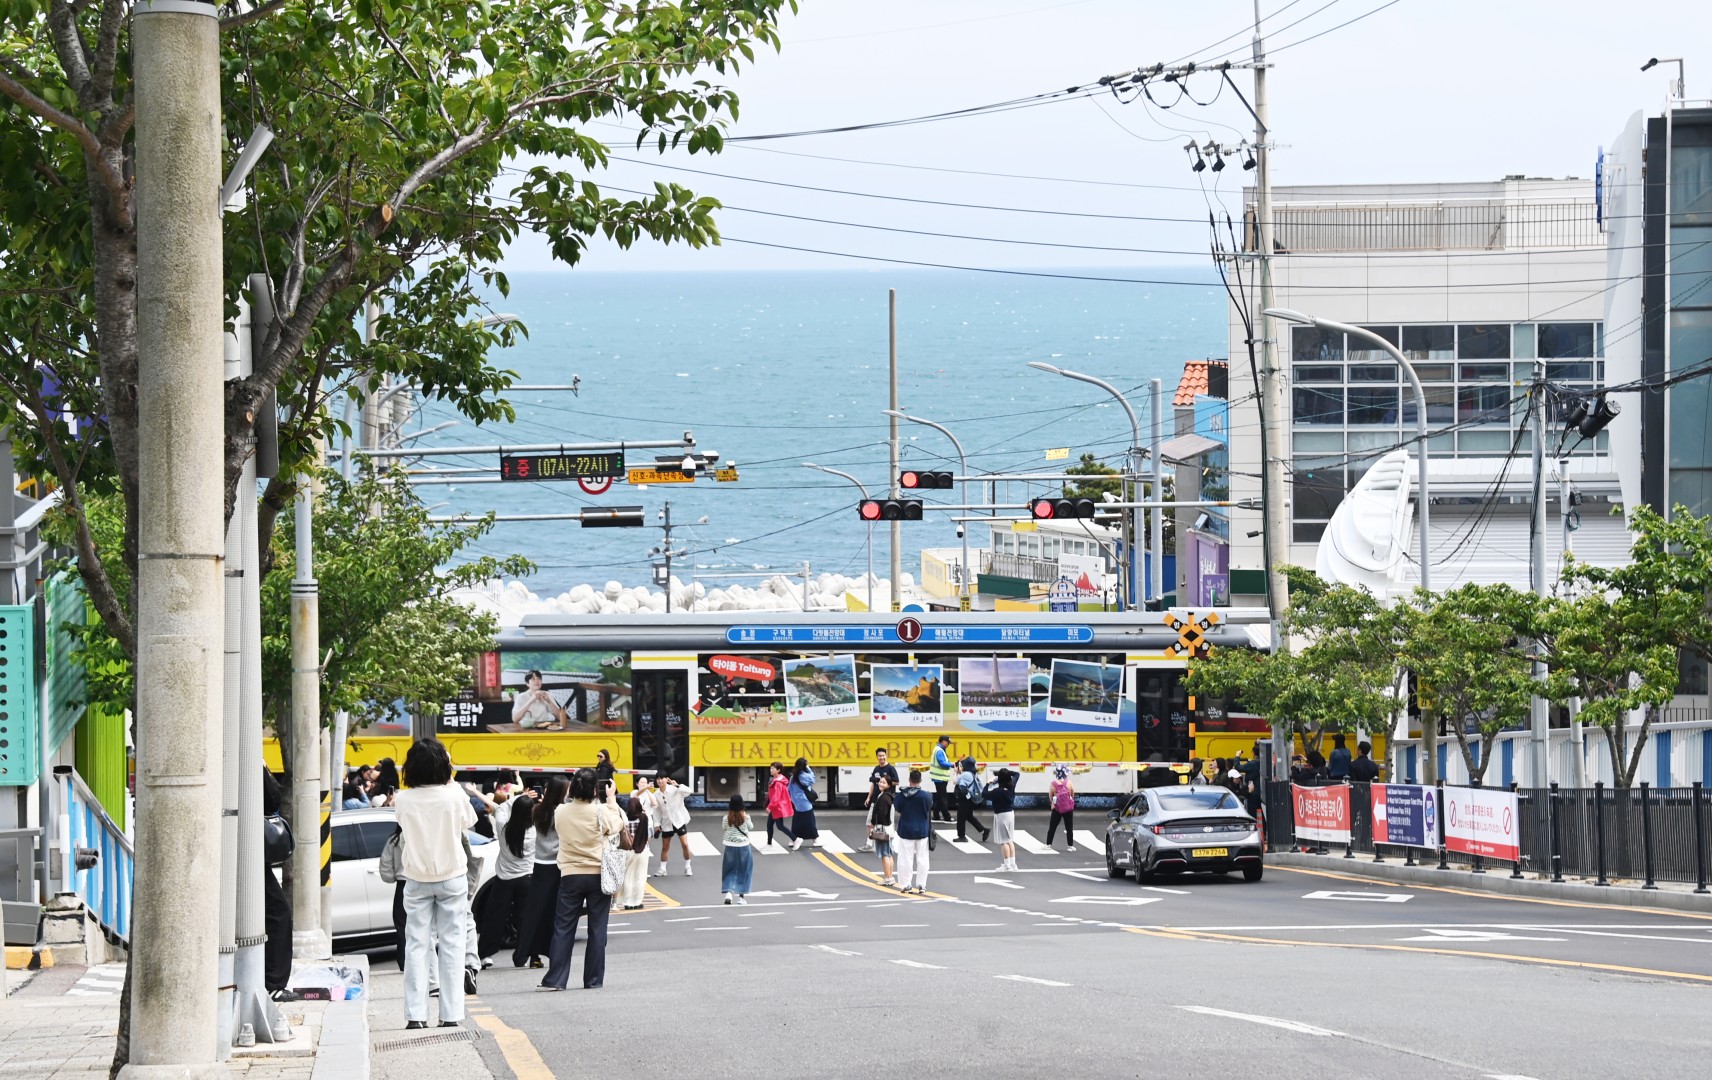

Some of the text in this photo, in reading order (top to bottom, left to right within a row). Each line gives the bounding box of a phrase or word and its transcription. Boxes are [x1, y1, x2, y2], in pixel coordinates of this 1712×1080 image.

[904, 621, 914, 639] 1
[1173, 621, 1181, 629] 멈
[1201, 620, 1208, 629] 멈
[1174, 642, 1182, 651] 춤
[712, 659, 772, 678] 타이동 Taitung
[444, 702, 484, 715] 또 만나
[443, 715, 478, 727] 대만!
[695, 716, 745, 725] TAIWAN
[730, 741, 1099, 760] HAEUNDAE BLULINE PARK
